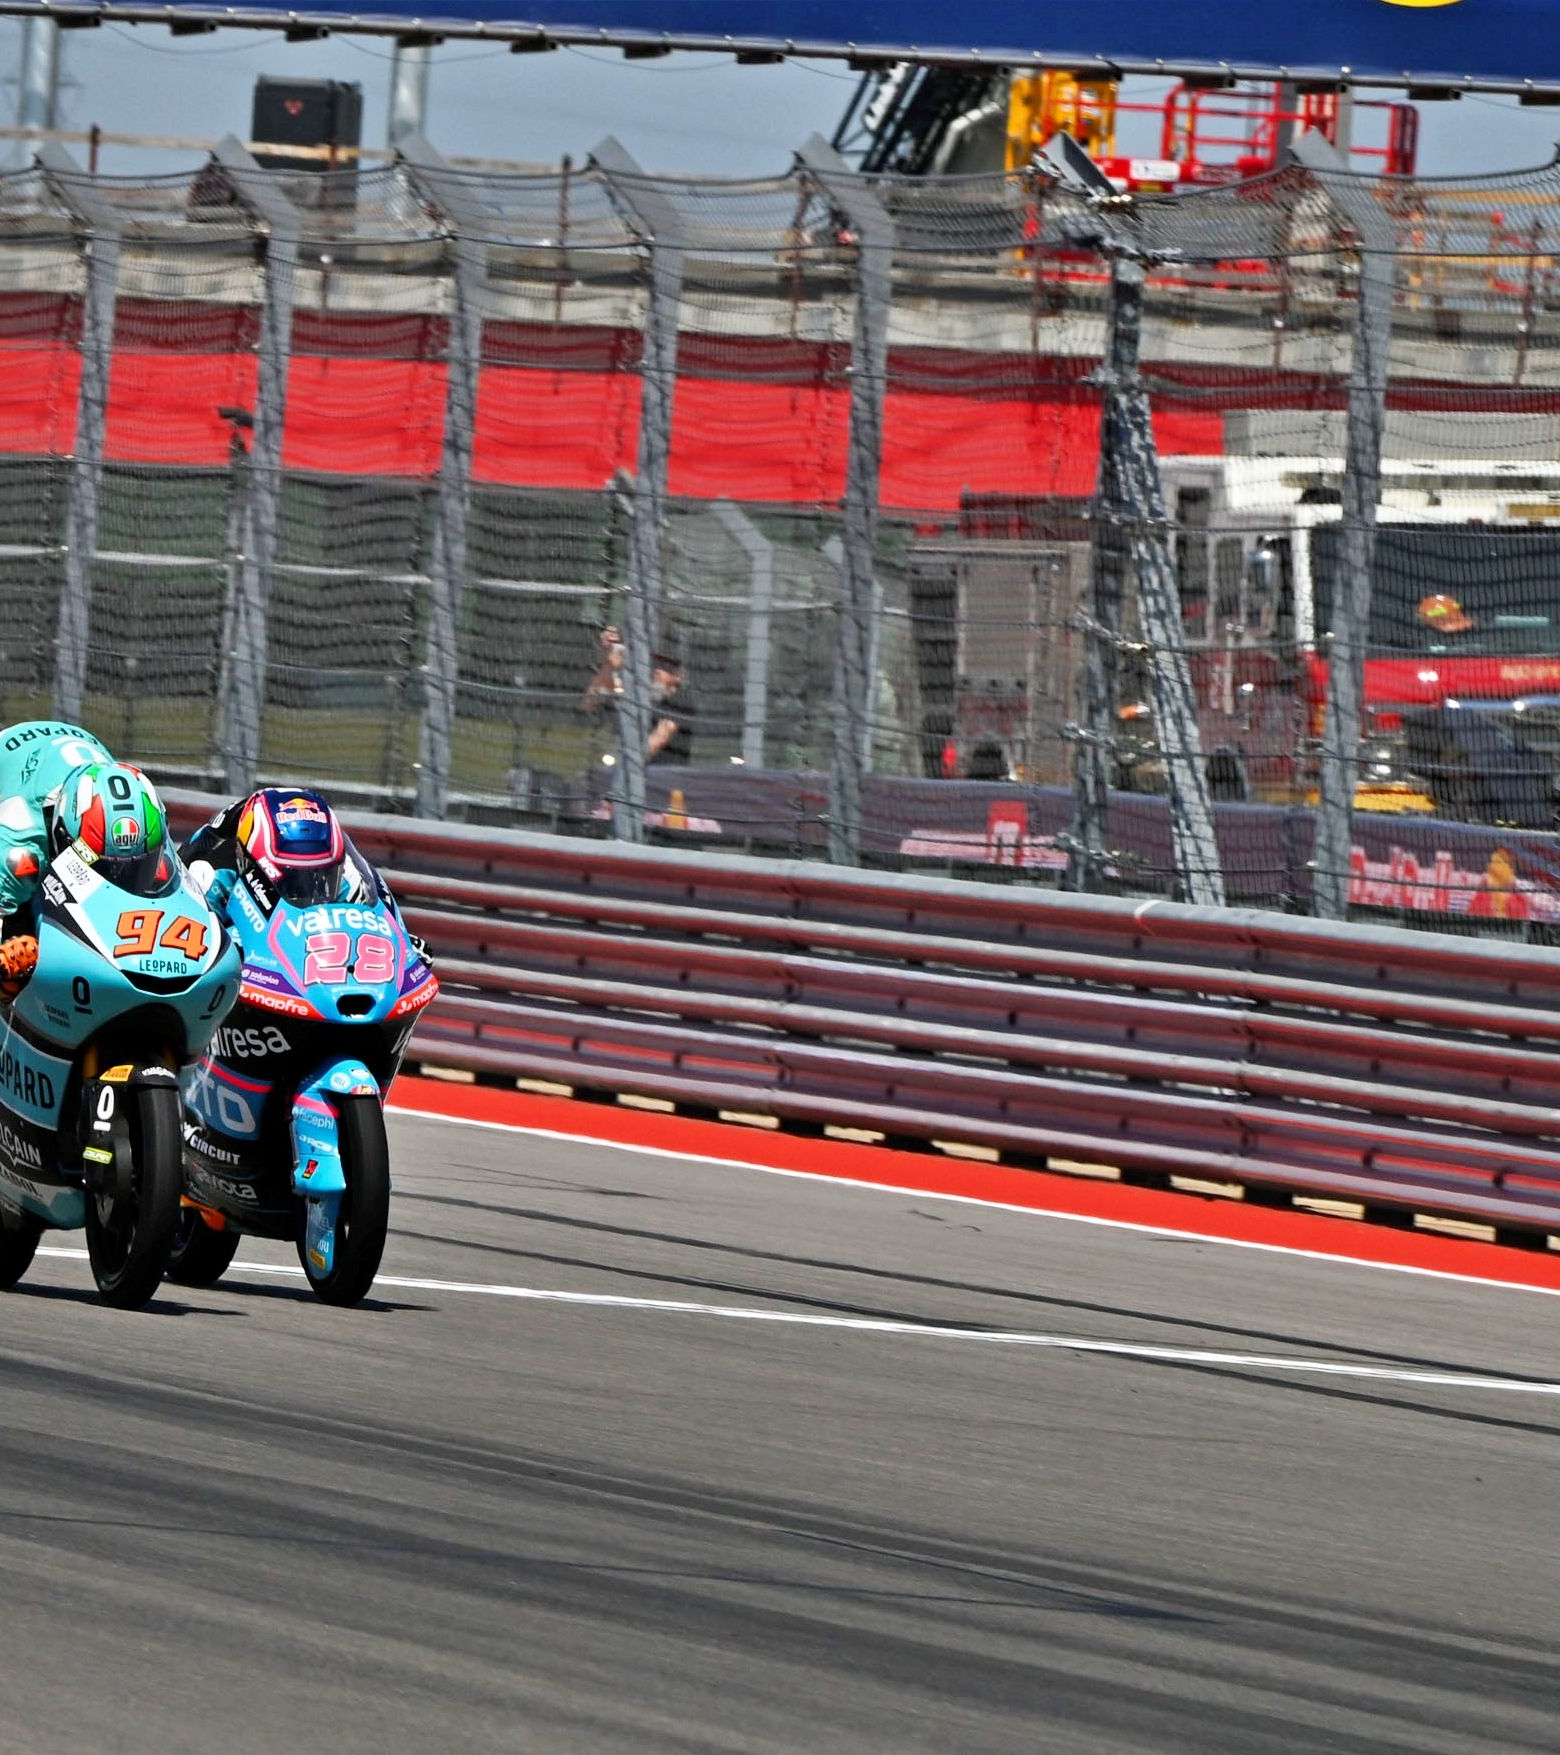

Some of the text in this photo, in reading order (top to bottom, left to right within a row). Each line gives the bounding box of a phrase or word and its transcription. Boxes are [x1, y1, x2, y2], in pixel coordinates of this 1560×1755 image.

[115, 834, 138, 846] agv
[113, 909, 208, 961] 94
[286, 908, 392, 936] valresa
[139, 959, 188, 975] LEOPARD
[304, 931, 395, 985] 28
[250, 992, 309, 1016] mapfre
[190, 1134, 240, 1165] CIRCUIT
